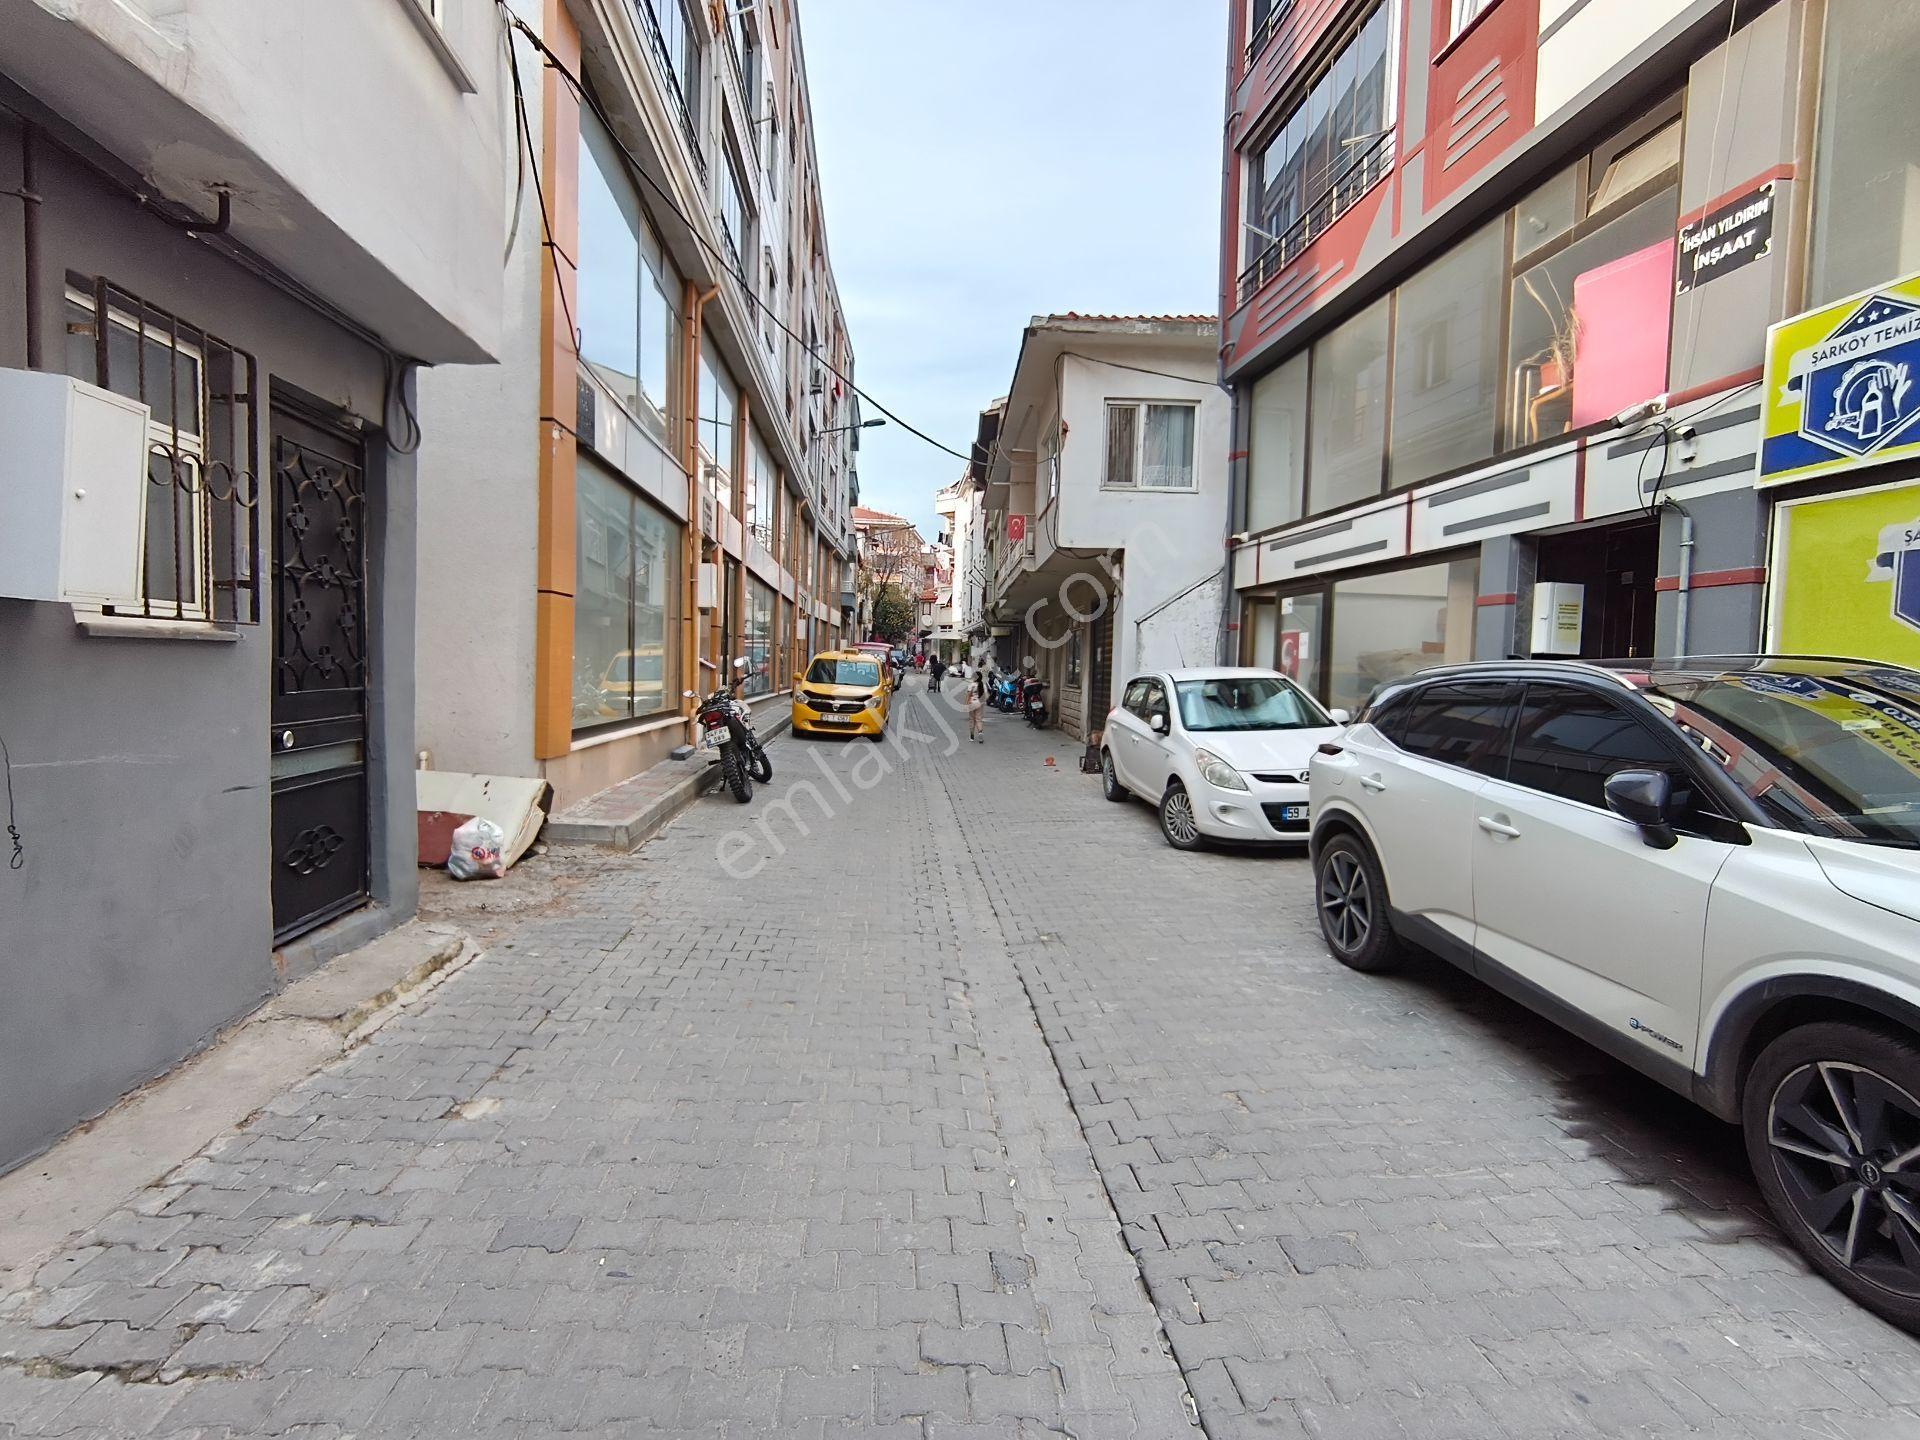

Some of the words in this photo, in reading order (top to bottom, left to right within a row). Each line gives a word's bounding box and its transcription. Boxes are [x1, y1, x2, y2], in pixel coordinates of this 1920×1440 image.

[1682, 224, 1718, 254] İHSAN
[1718, 198, 1769, 235] YILDIRIM
[1811, 333, 1870, 367] ŞARKÖY
[1287, 807, 1300, 819] 59
